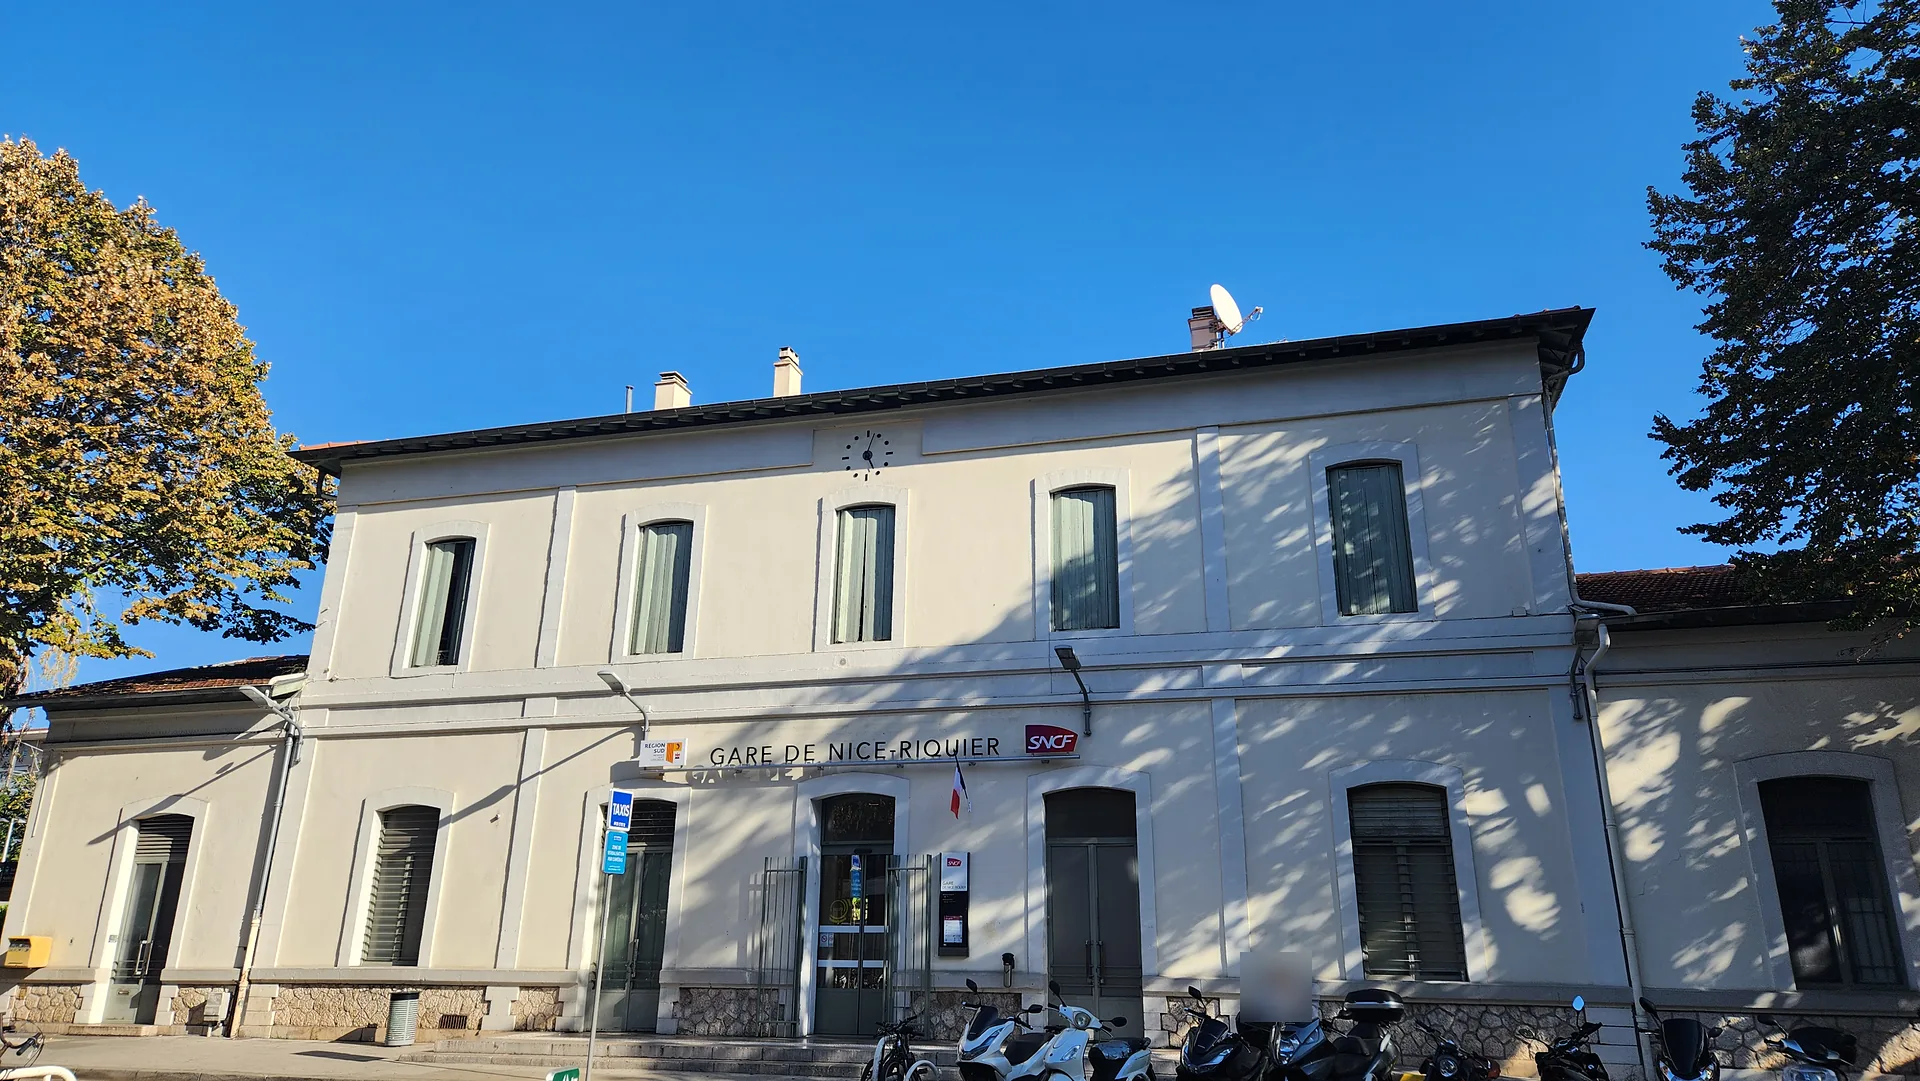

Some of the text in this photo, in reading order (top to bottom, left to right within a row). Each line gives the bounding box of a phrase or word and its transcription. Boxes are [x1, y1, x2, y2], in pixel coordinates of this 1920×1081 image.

[1028, 734, 1074, 750] SNCF
[710, 737, 1000, 766] GARE DE NICE-RIQUIER
[613, 803, 630, 817] TAXIS
